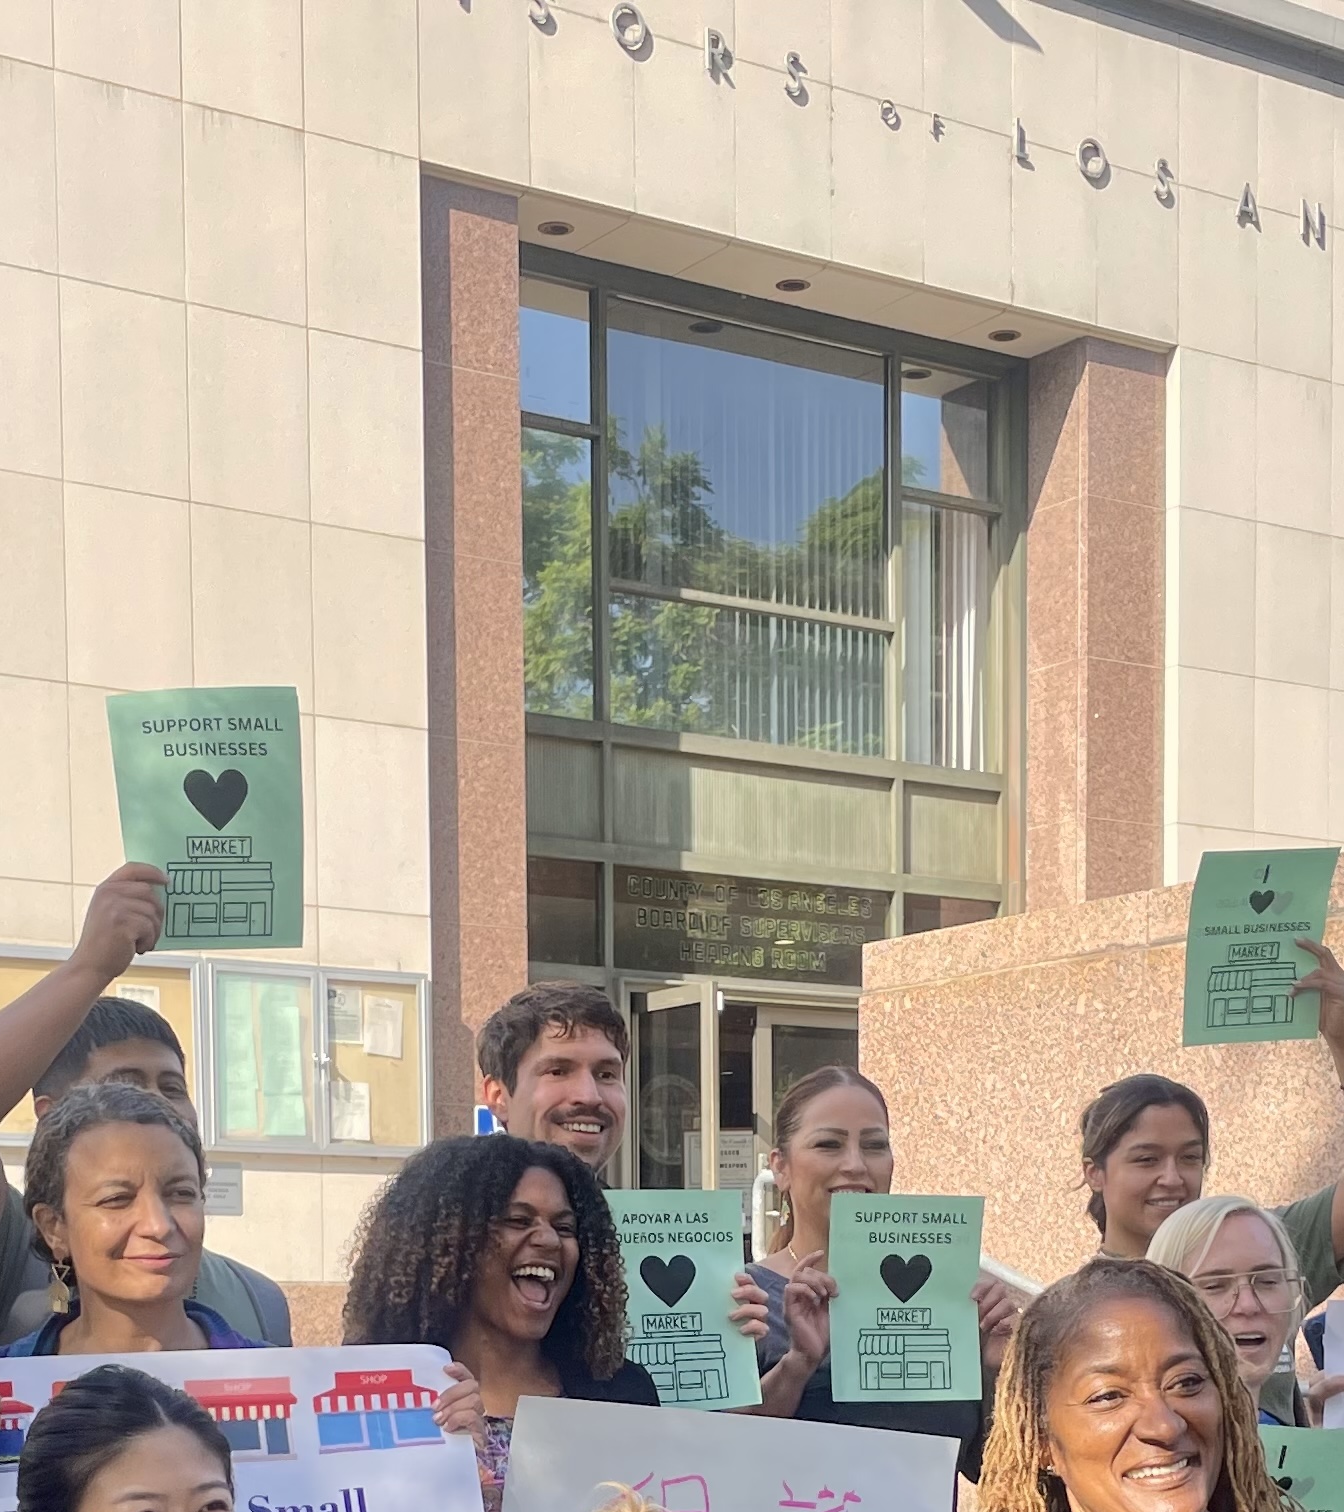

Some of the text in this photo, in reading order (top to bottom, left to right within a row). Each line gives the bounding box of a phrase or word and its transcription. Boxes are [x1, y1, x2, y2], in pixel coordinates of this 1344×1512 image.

[880, 99, 945, 137] OF
[1012, 117, 1172, 200] LOS
[142, 717, 283, 734] SUPPORT SMALL
[164, 742, 268, 757] BUSINESSES
[191, 838, 247, 855] MARKET
[1262, 864, 1270, 884] I
[627, 874, 873, 919] COUNTY OF LOS ANGELES
[636, 907, 866, 945] BOARD OF SUPERVISORS
[1205, 921, 1311, 936] SMALL BUSINESSES
[680, 940, 827, 973] HEARING ROOM
[1231, 944, 1276, 958] MARKET
[622, 1212, 709, 1224] APOYAR A LAS
[855, 1210, 968, 1225] SUPPORT SMALL
[668, 1231, 734, 1243] NEGOCIOS
[868, 1231, 952, 1244] BUSINESSES
[646, 1315, 696, 1330] MARKET
[880, 1309, 928, 1324] MARKET
[359, 1374, 388, 1385] SHOP
[1278, 1445, 1287, 1469] I
